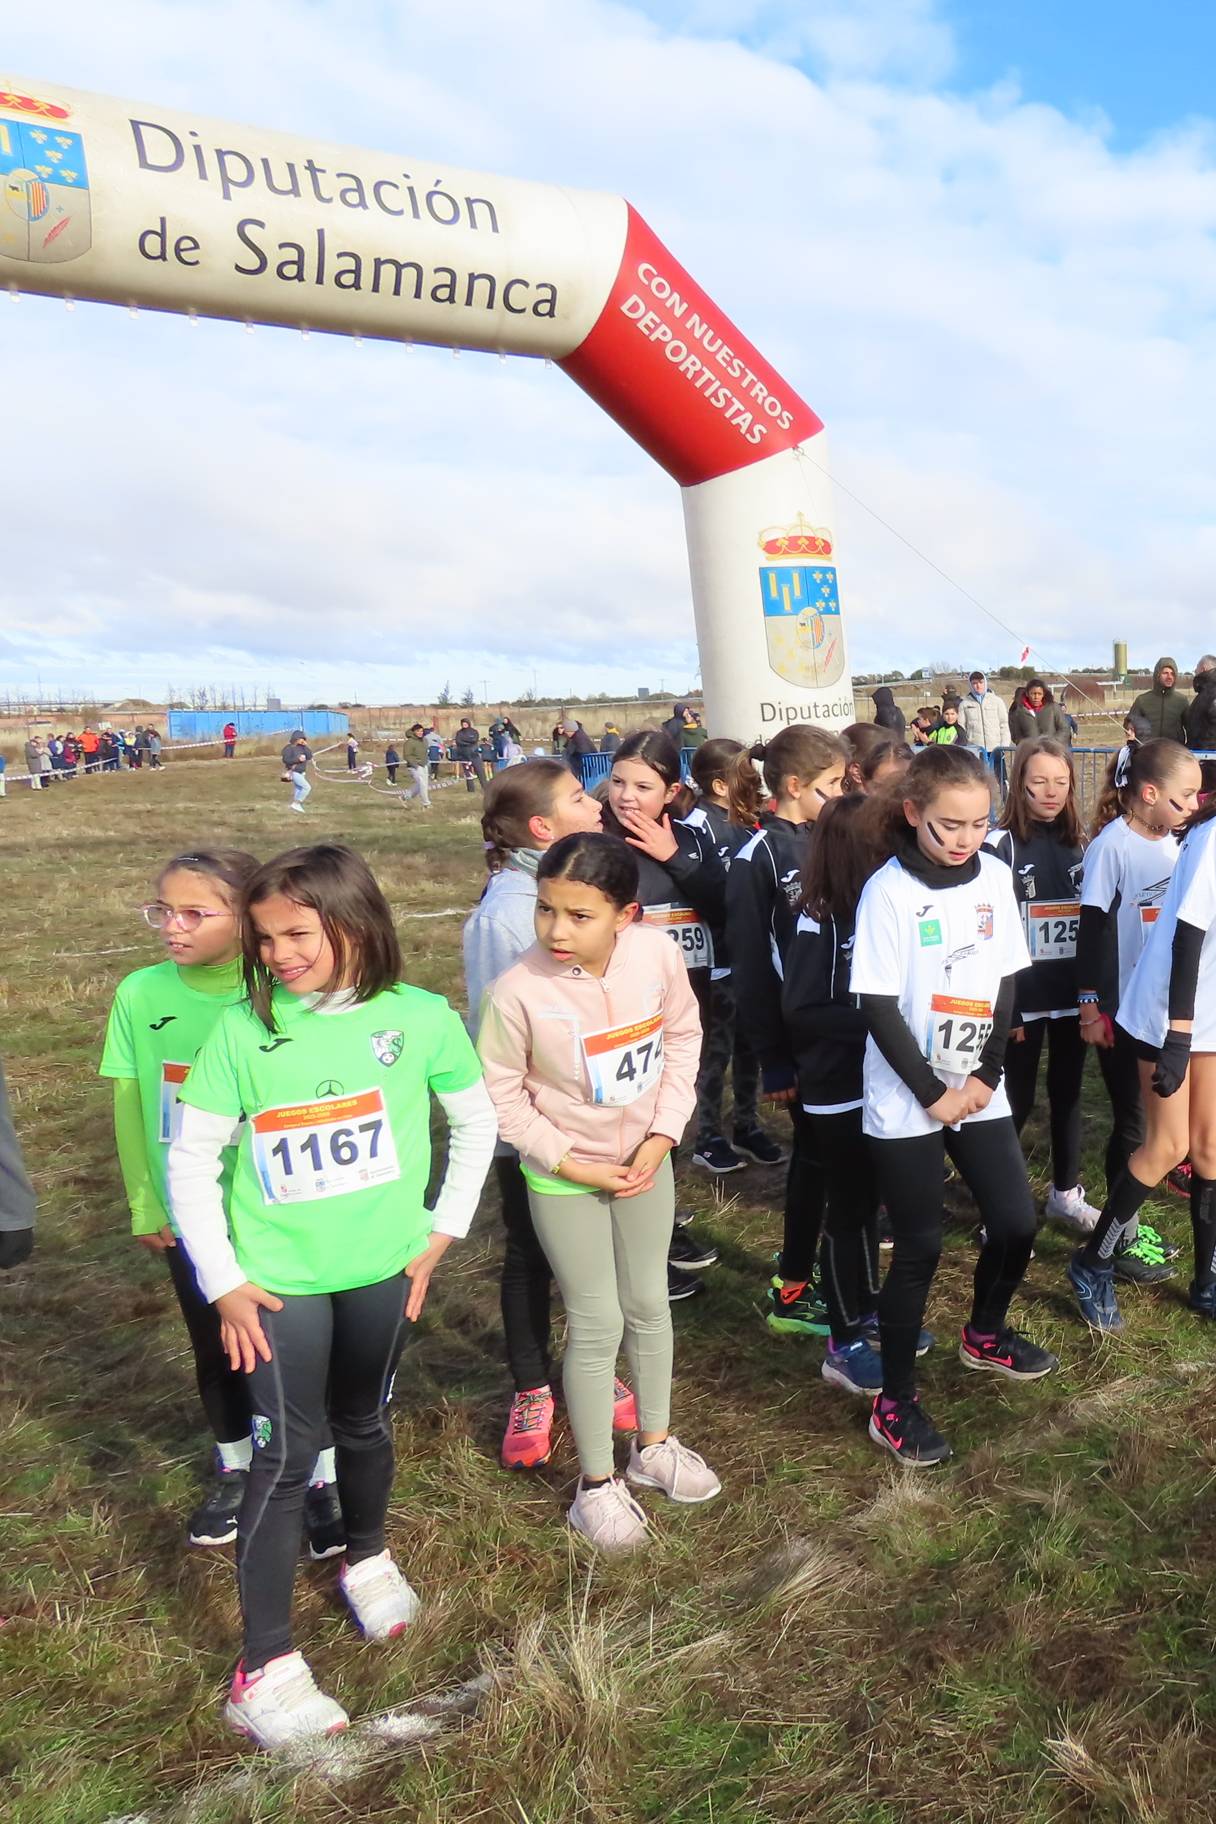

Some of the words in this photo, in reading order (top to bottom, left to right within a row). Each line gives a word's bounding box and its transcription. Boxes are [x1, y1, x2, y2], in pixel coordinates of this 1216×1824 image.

[128, 118, 500, 234] Diputación
[138, 216, 201, 266] de
[234, 217, 559, 318] Salamanca
[620, 294, 768, 444] DEPORTISTAS
[636, 262, 689, 318] CON
[685, 312, 794, 430] NUESTROS
[271, 1118, 384, 1176] 1167
[276, 1108, 308, 1119] JUEGOS
